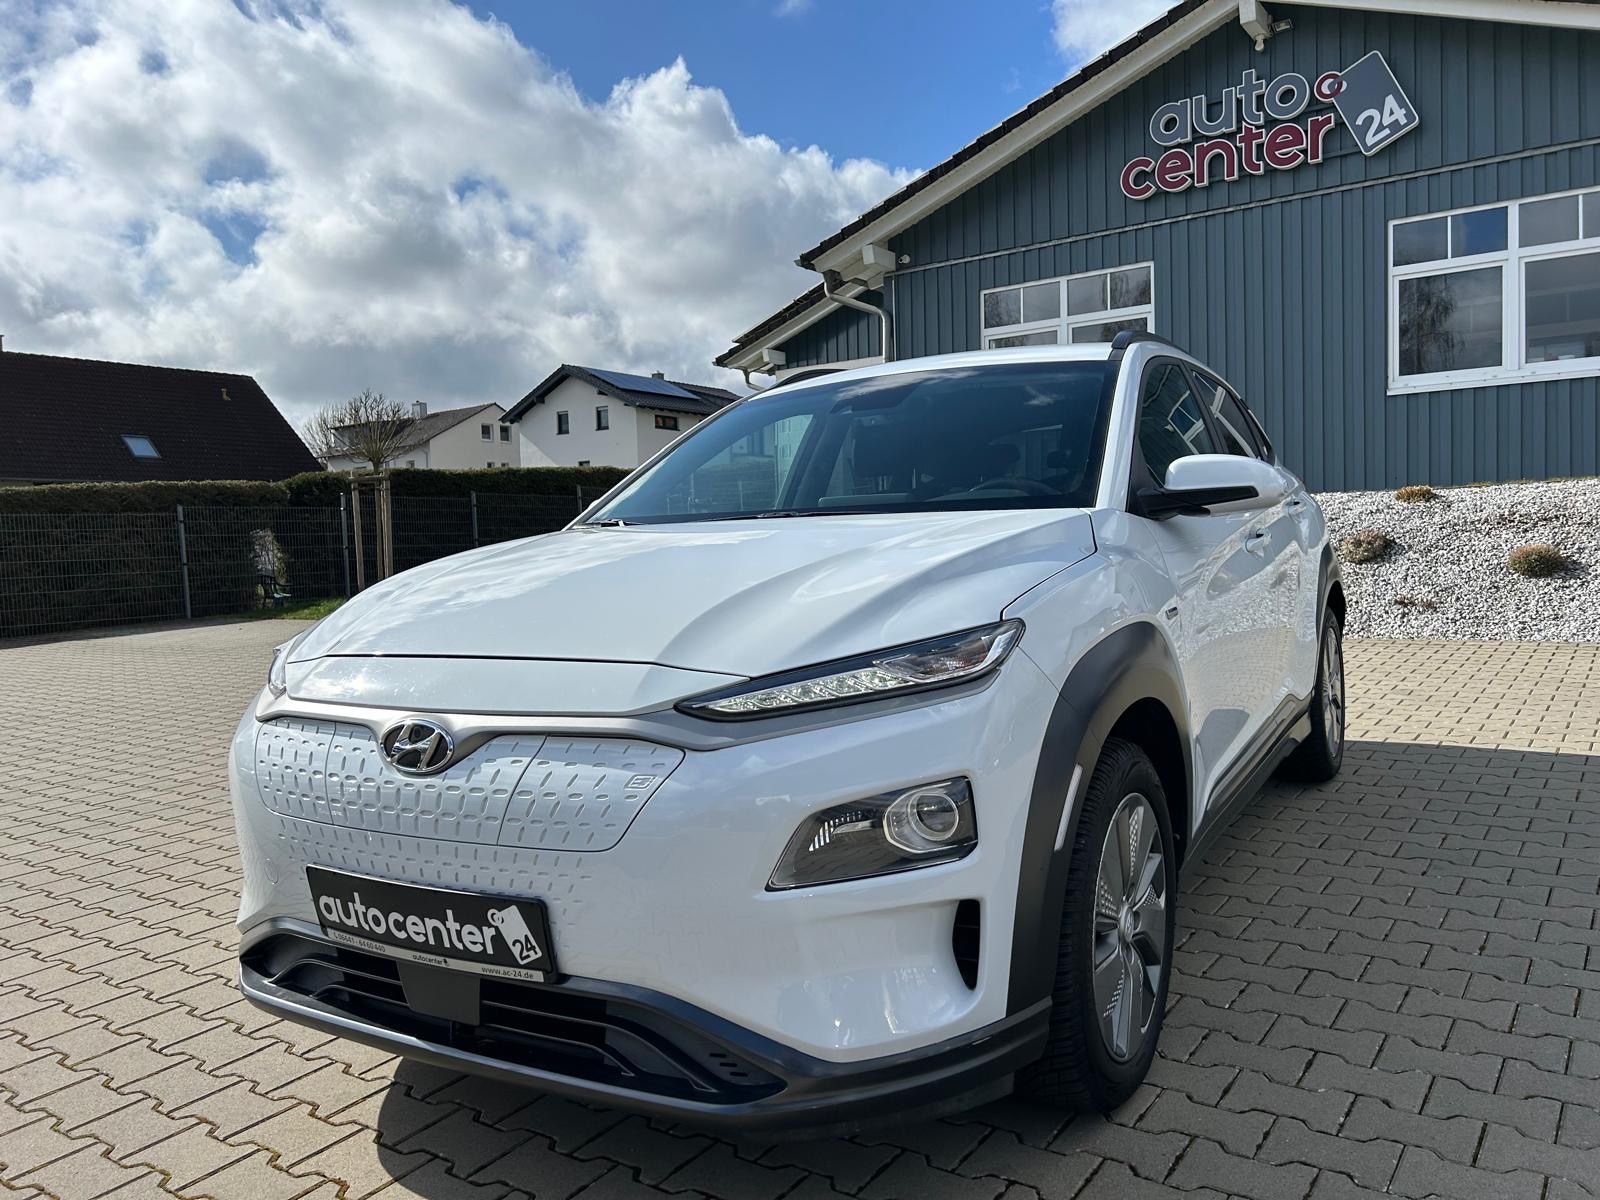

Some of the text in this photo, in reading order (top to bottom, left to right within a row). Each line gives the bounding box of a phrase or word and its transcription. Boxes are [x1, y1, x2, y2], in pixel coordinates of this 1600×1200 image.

[1149, 69, 1310, 146] auto
[1355, 93, 1407, 147] 24
[1120, 113, 1335, 199] center
[319, 892, 537, 961] autocenter 24
[481, 966, 534, 979] www.ac-24.de
